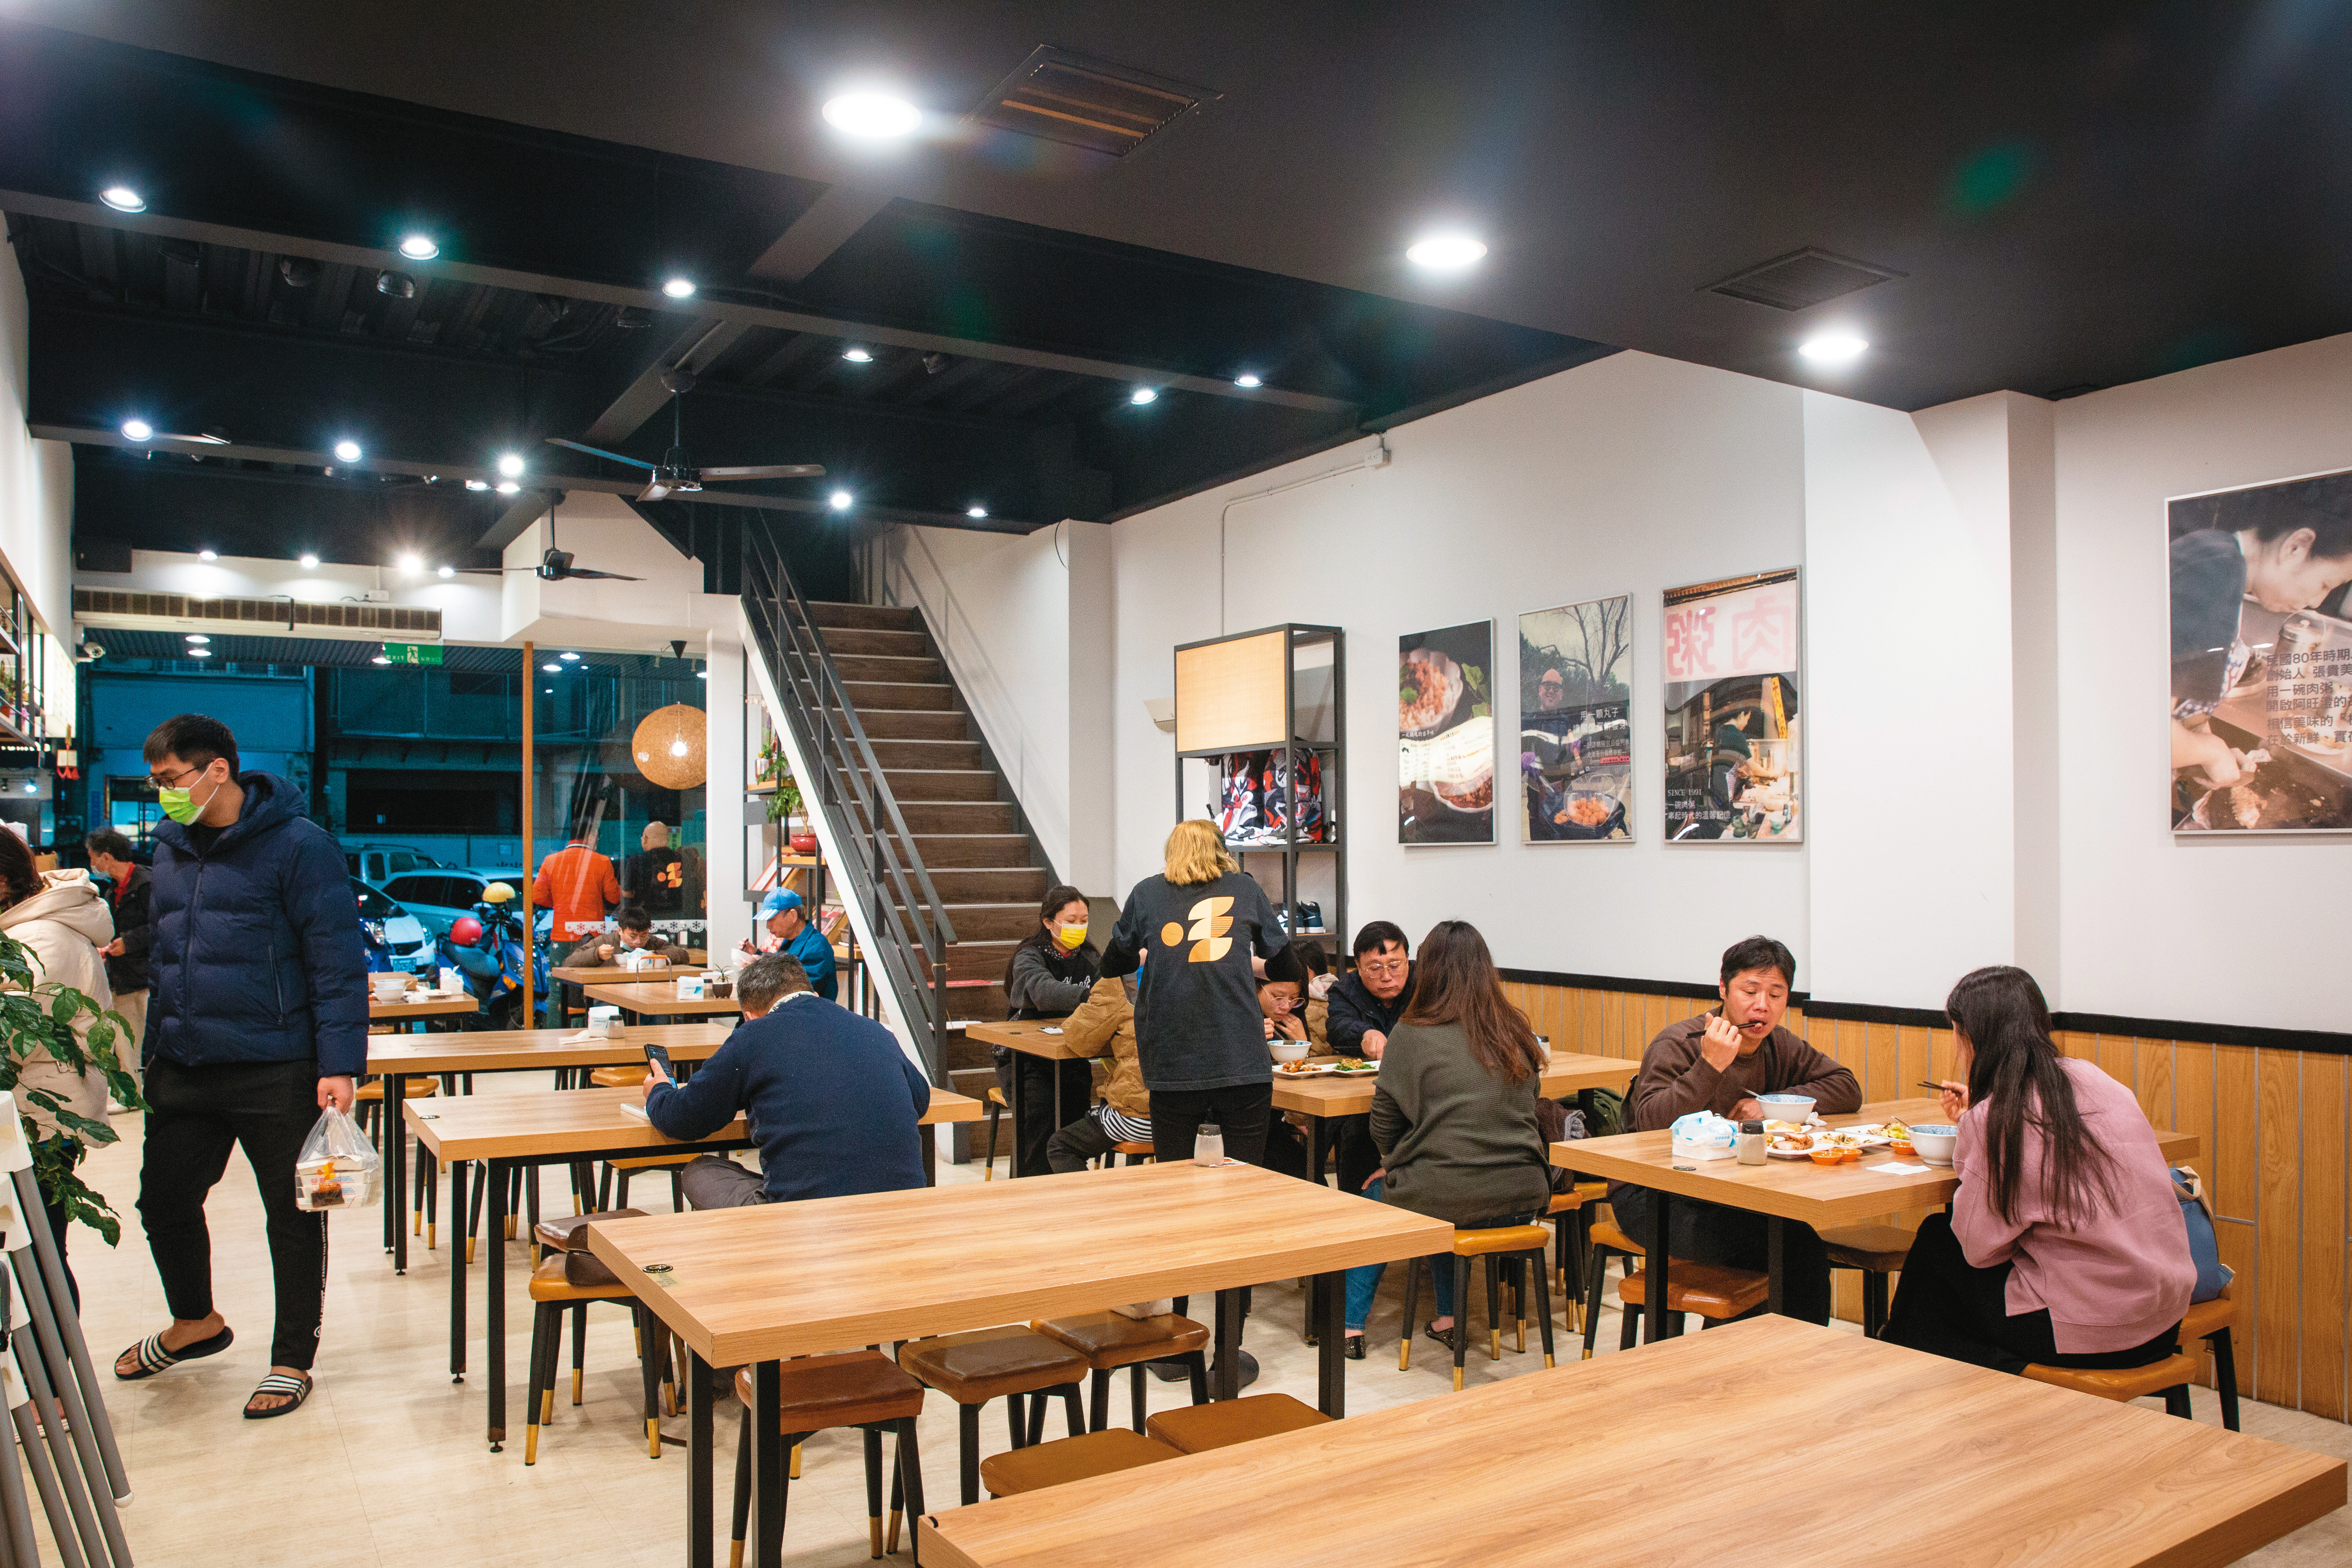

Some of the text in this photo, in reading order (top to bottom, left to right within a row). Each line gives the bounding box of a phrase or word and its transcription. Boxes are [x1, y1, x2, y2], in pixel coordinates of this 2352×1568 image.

[2266, 668, 2305, 681] 創始人
[1581, 707, 1619, 720] 用一顆丸子
[2267, 713, 2352, 730] 相信美味的『
[1669, 800, 1695, 809] 一碗肉粥
